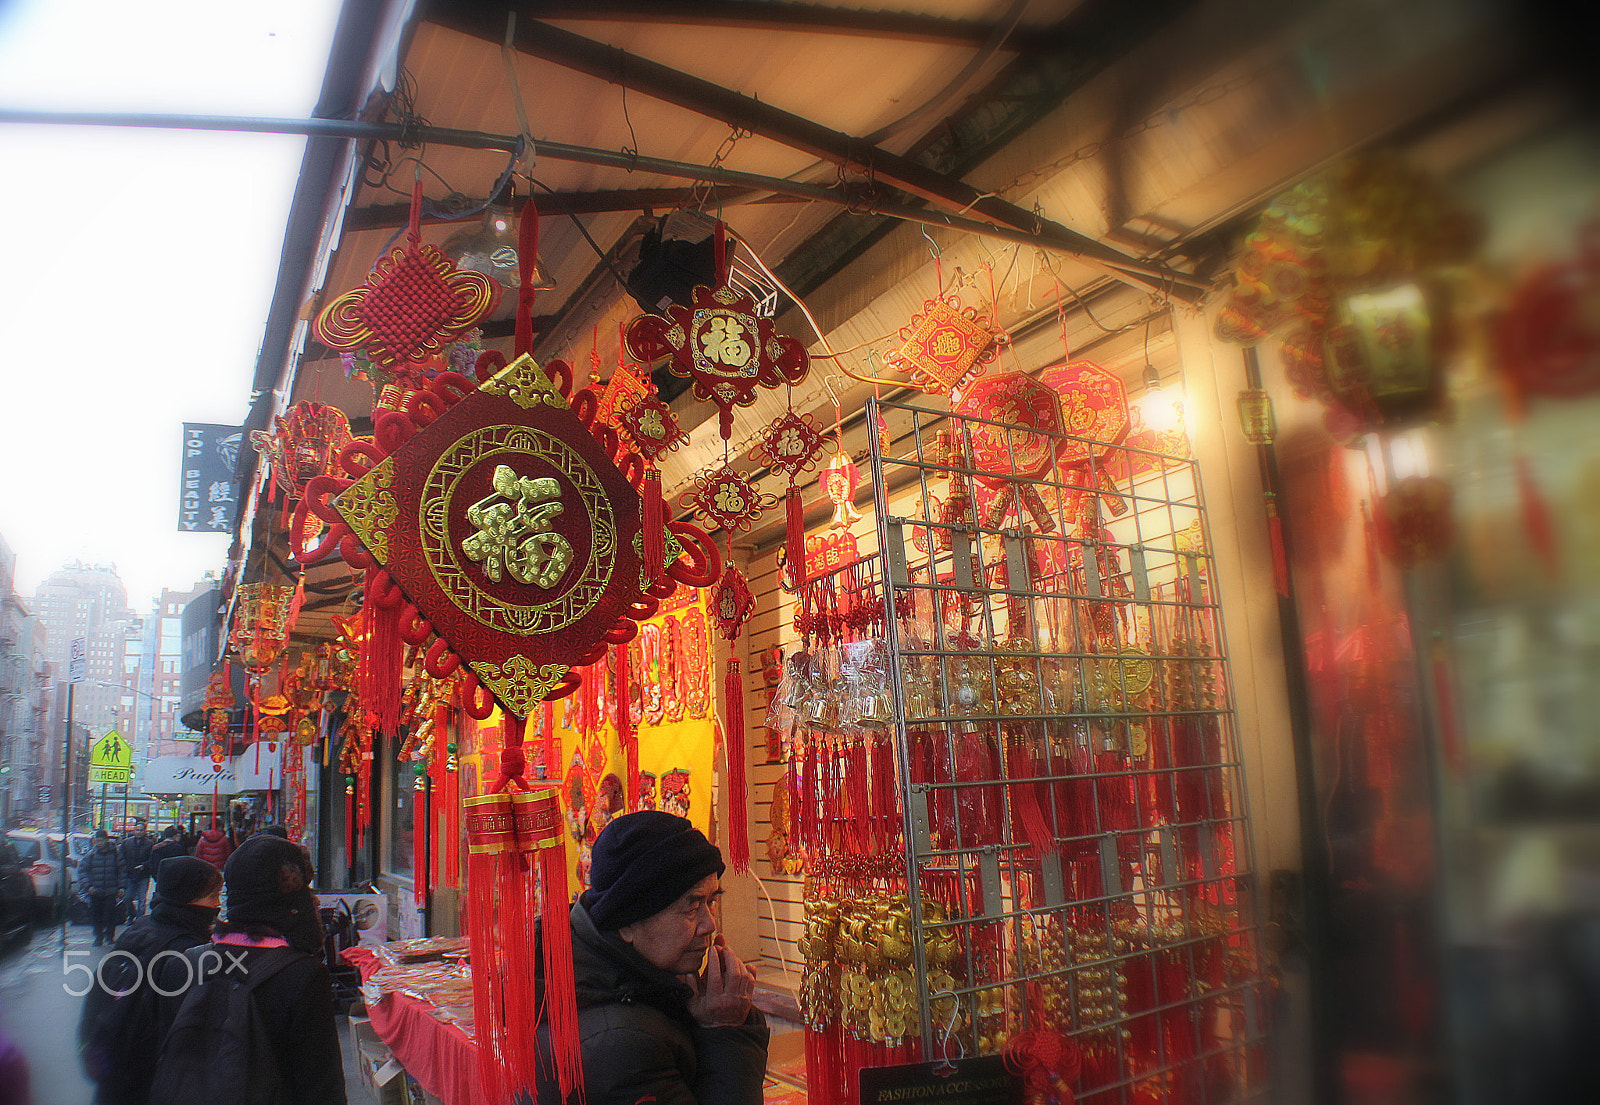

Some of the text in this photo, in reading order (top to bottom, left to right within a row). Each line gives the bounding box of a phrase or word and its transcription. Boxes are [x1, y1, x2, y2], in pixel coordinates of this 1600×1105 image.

[700, 316, 751, 367] 福
[182, 429, 205, 530] TOP BEAUTY
[713, 481, 745, 513] 福
[461, 463, 575, 590] 福
[94, 770, 126, 781] AHEAD
[877, 1085, 936, 1103] FASHION
